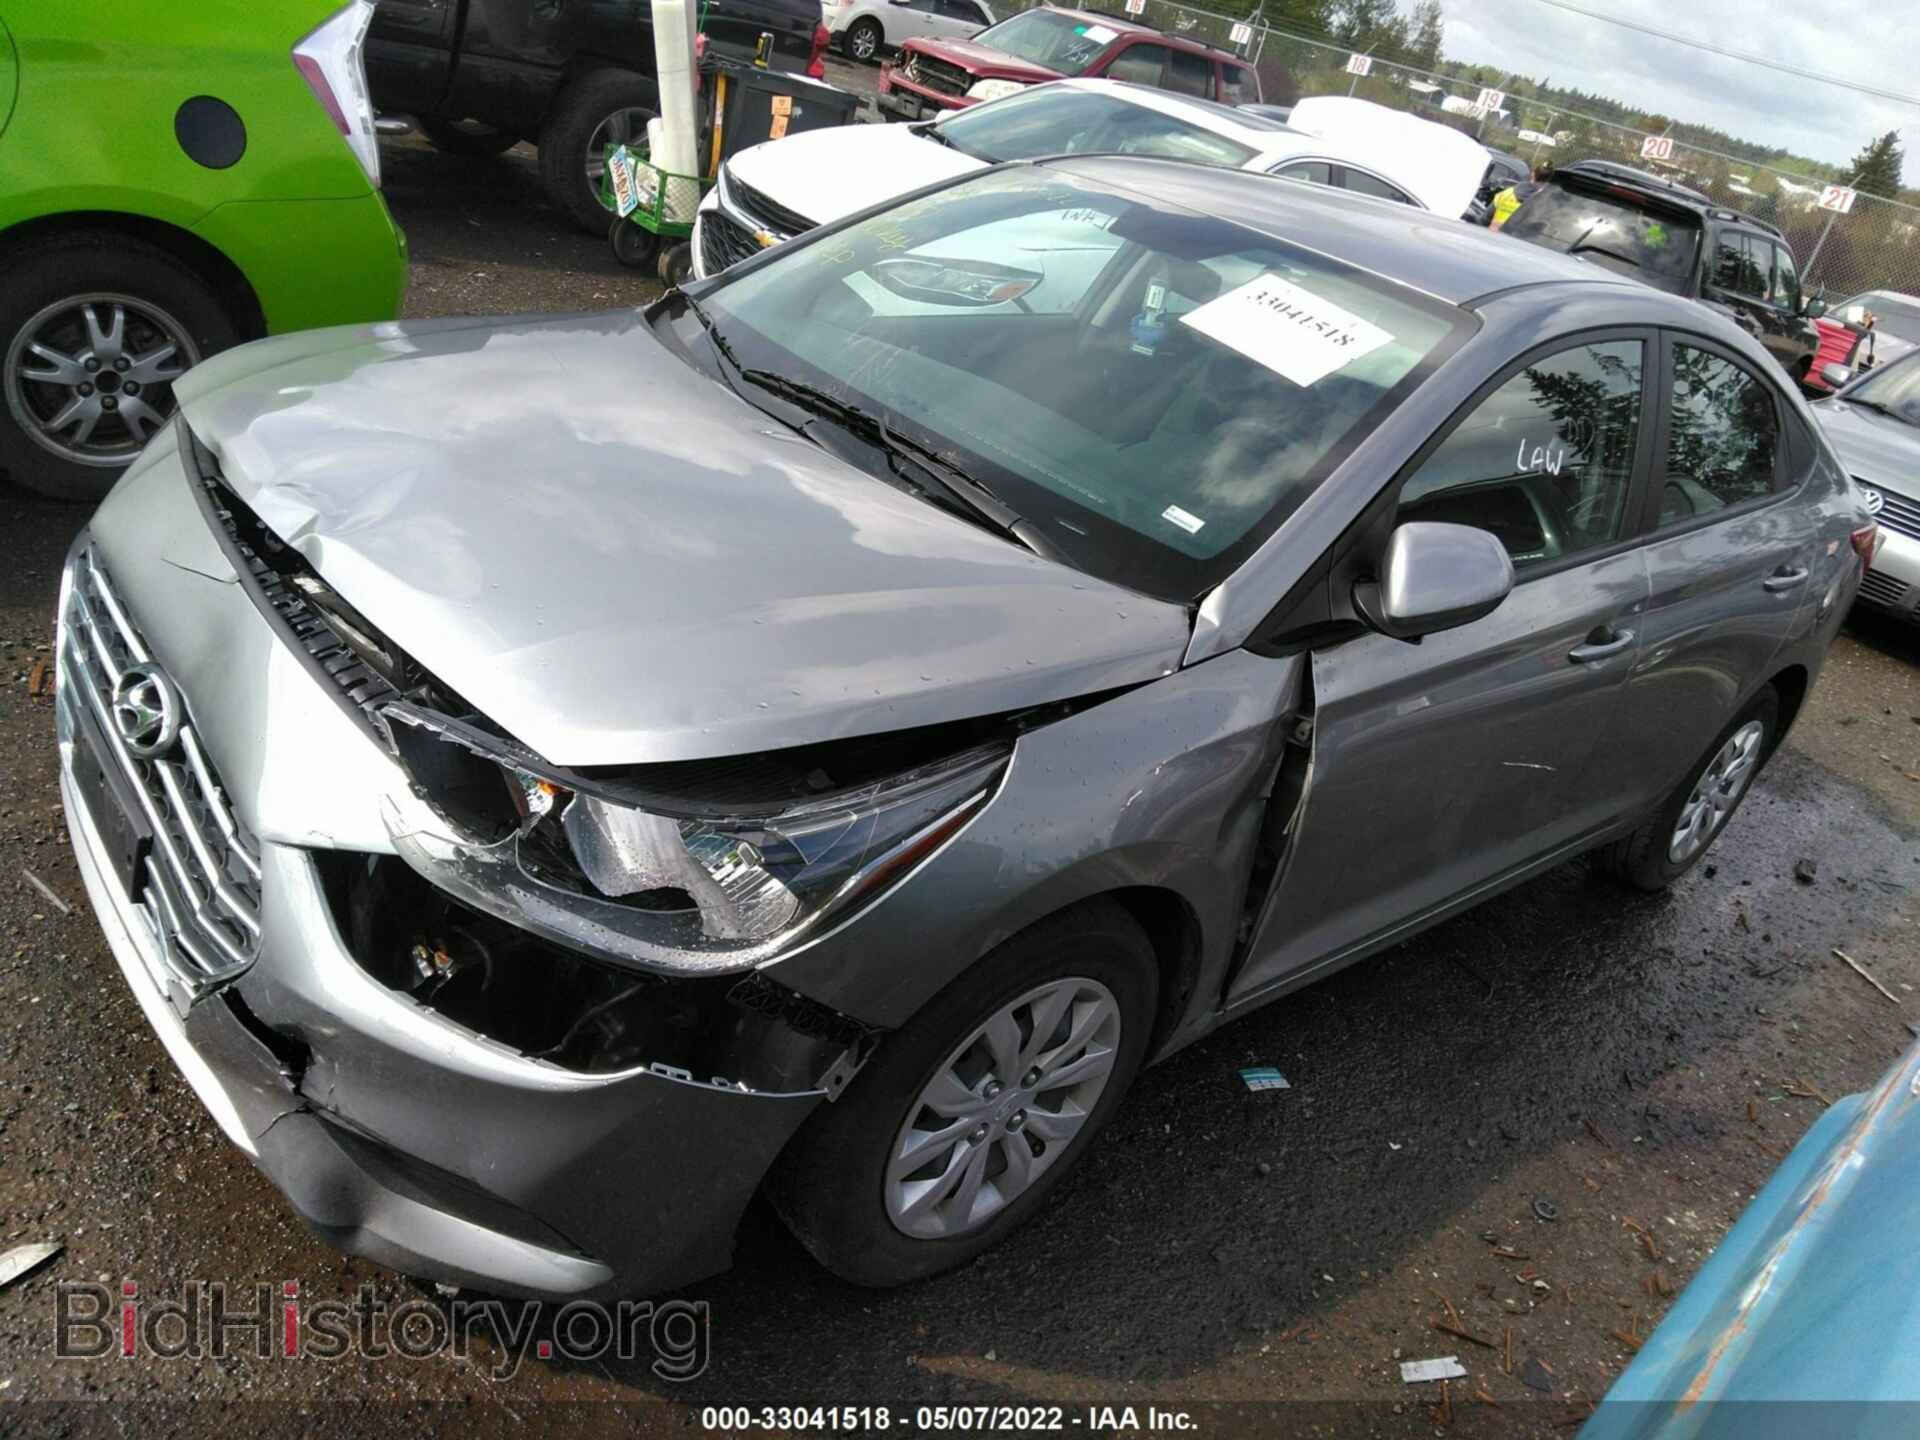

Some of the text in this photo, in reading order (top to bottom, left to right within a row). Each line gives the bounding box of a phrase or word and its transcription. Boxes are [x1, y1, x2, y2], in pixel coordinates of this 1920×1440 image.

[1351, 56, 1367, 73] 18
[1482, 90, 1499, 108] 19
[1644, 138, 1669, 157] 20
[1824, 187, 1850, 210] 21
[1246, 291, 1356, 347] 33041518
[1517, 437, 1564, 476] LAW
